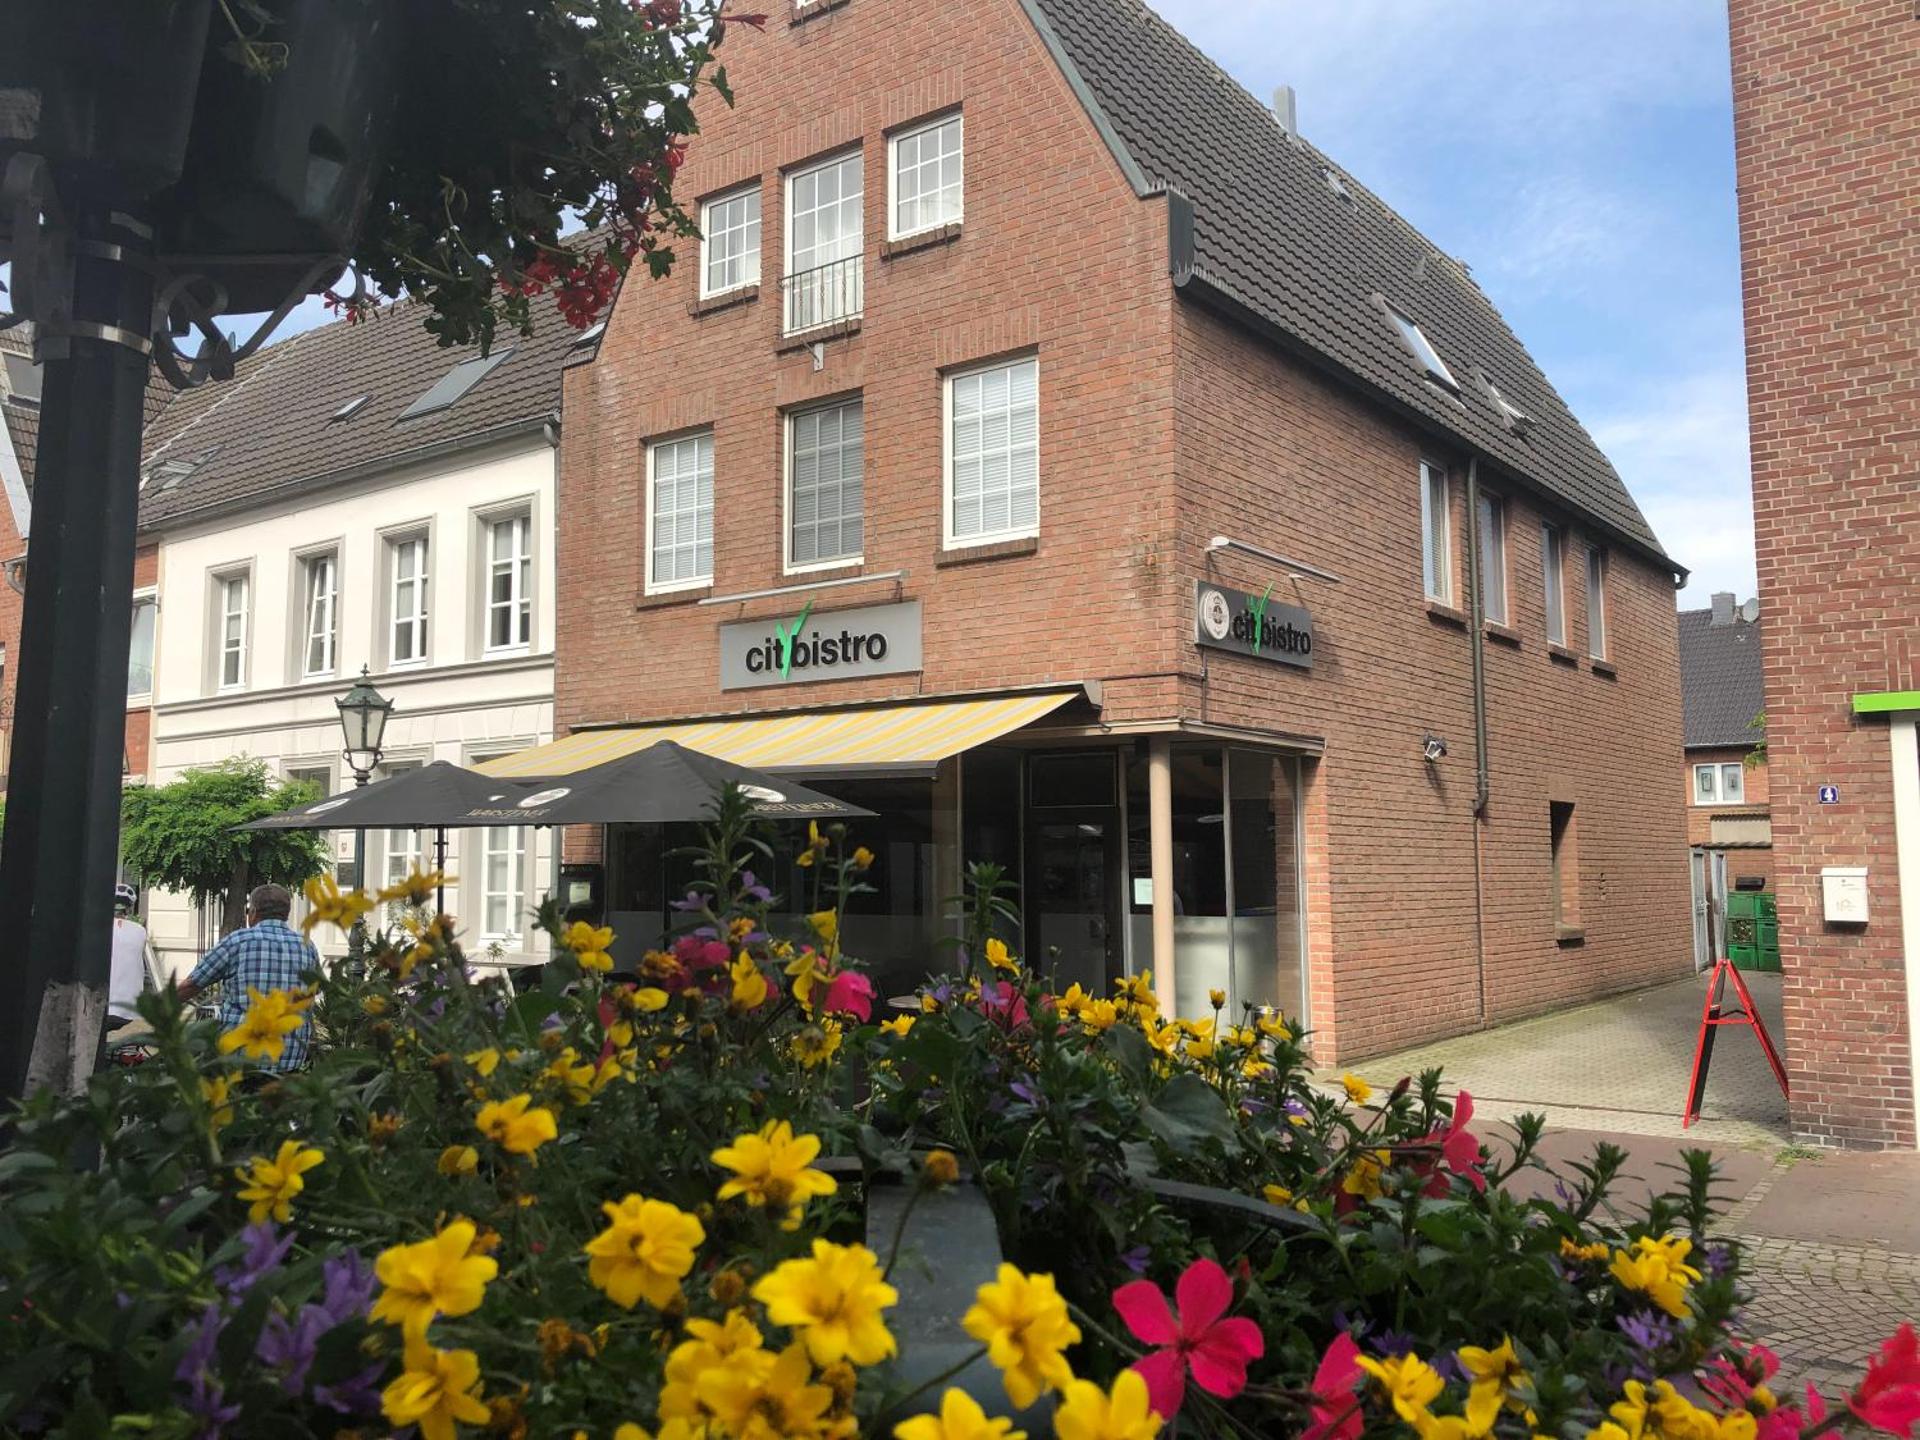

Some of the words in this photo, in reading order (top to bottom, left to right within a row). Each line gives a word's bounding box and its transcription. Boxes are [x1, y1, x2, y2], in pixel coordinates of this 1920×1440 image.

[745, 594, 888, 680] citybistro
[1232, 581, 1312, 655] citybistro
[1824, 787, 1833, 802] 4
